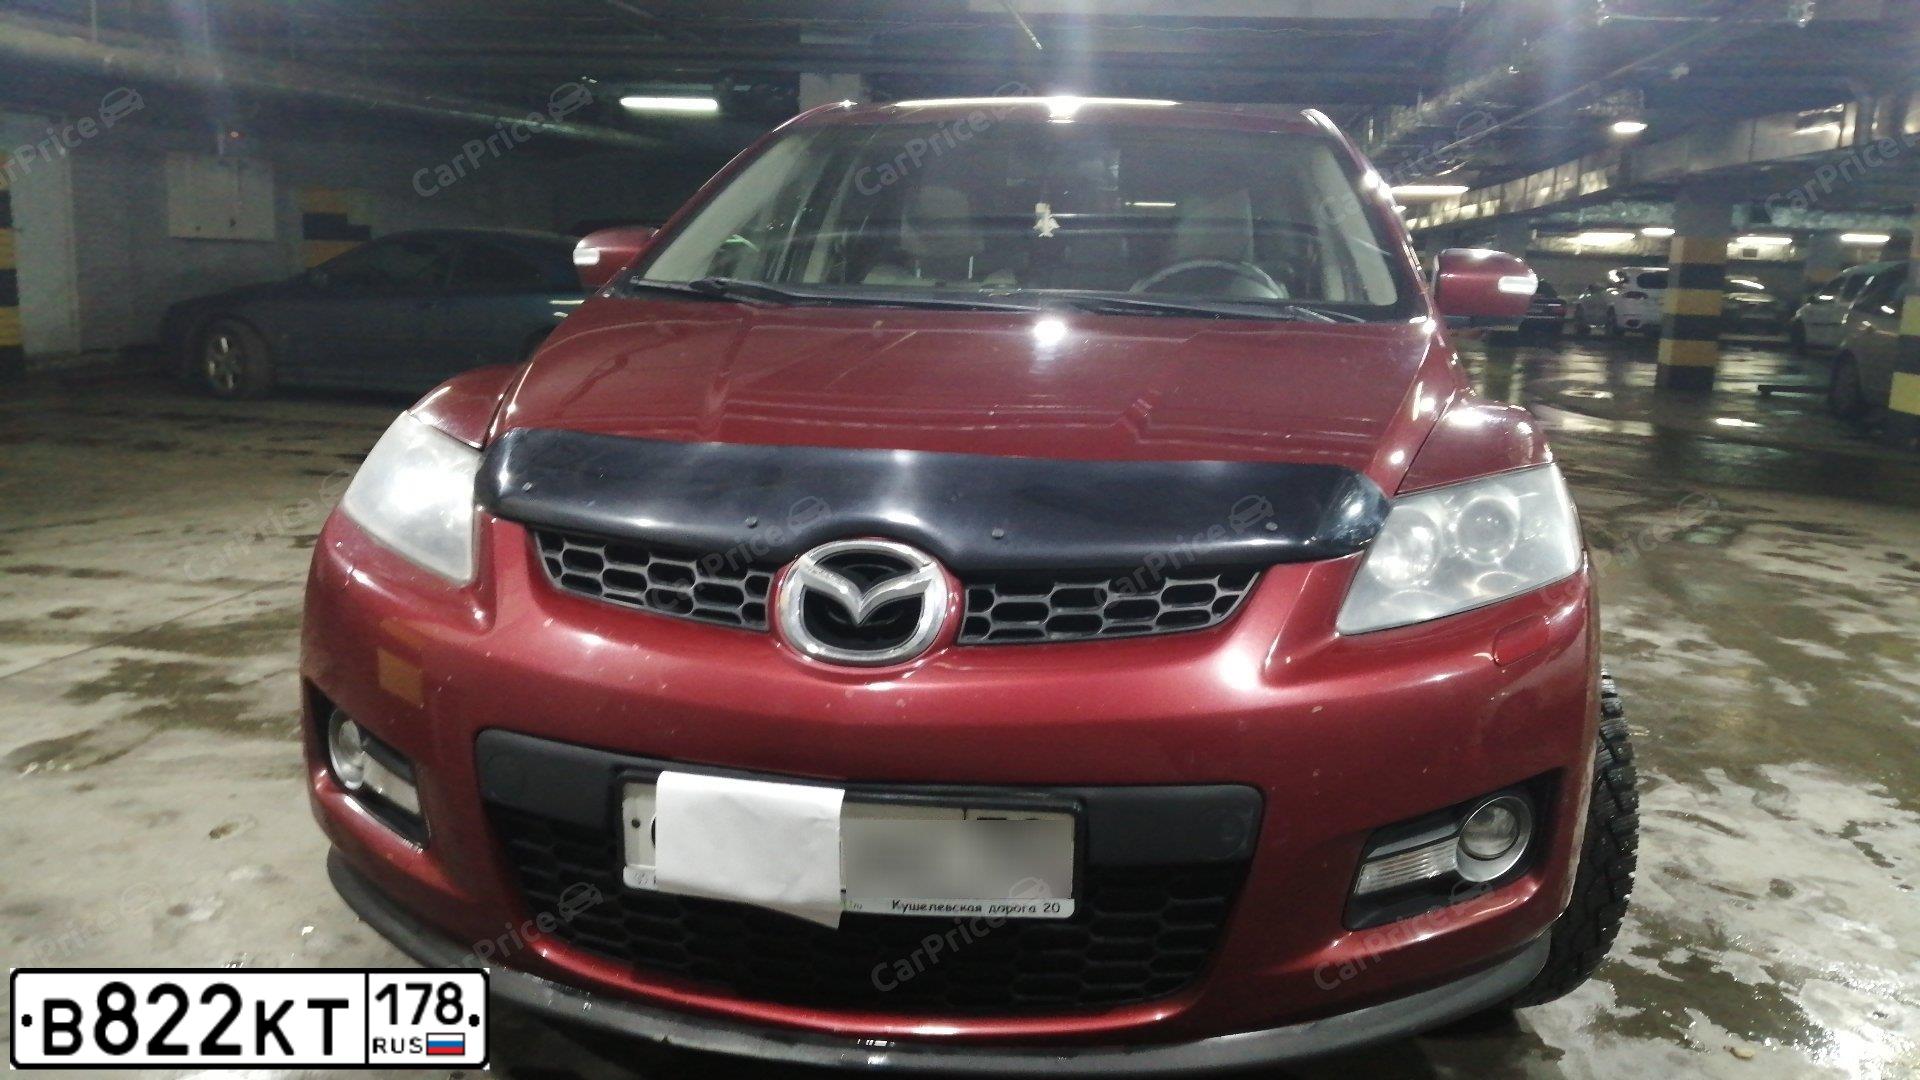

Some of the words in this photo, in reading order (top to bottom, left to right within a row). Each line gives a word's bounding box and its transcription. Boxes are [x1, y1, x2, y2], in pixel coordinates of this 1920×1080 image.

[892, 899, 982, 914] Кушелевская
[988, 902, 1037, 915] дорога
[1043, 902, 1061, 914] 20
